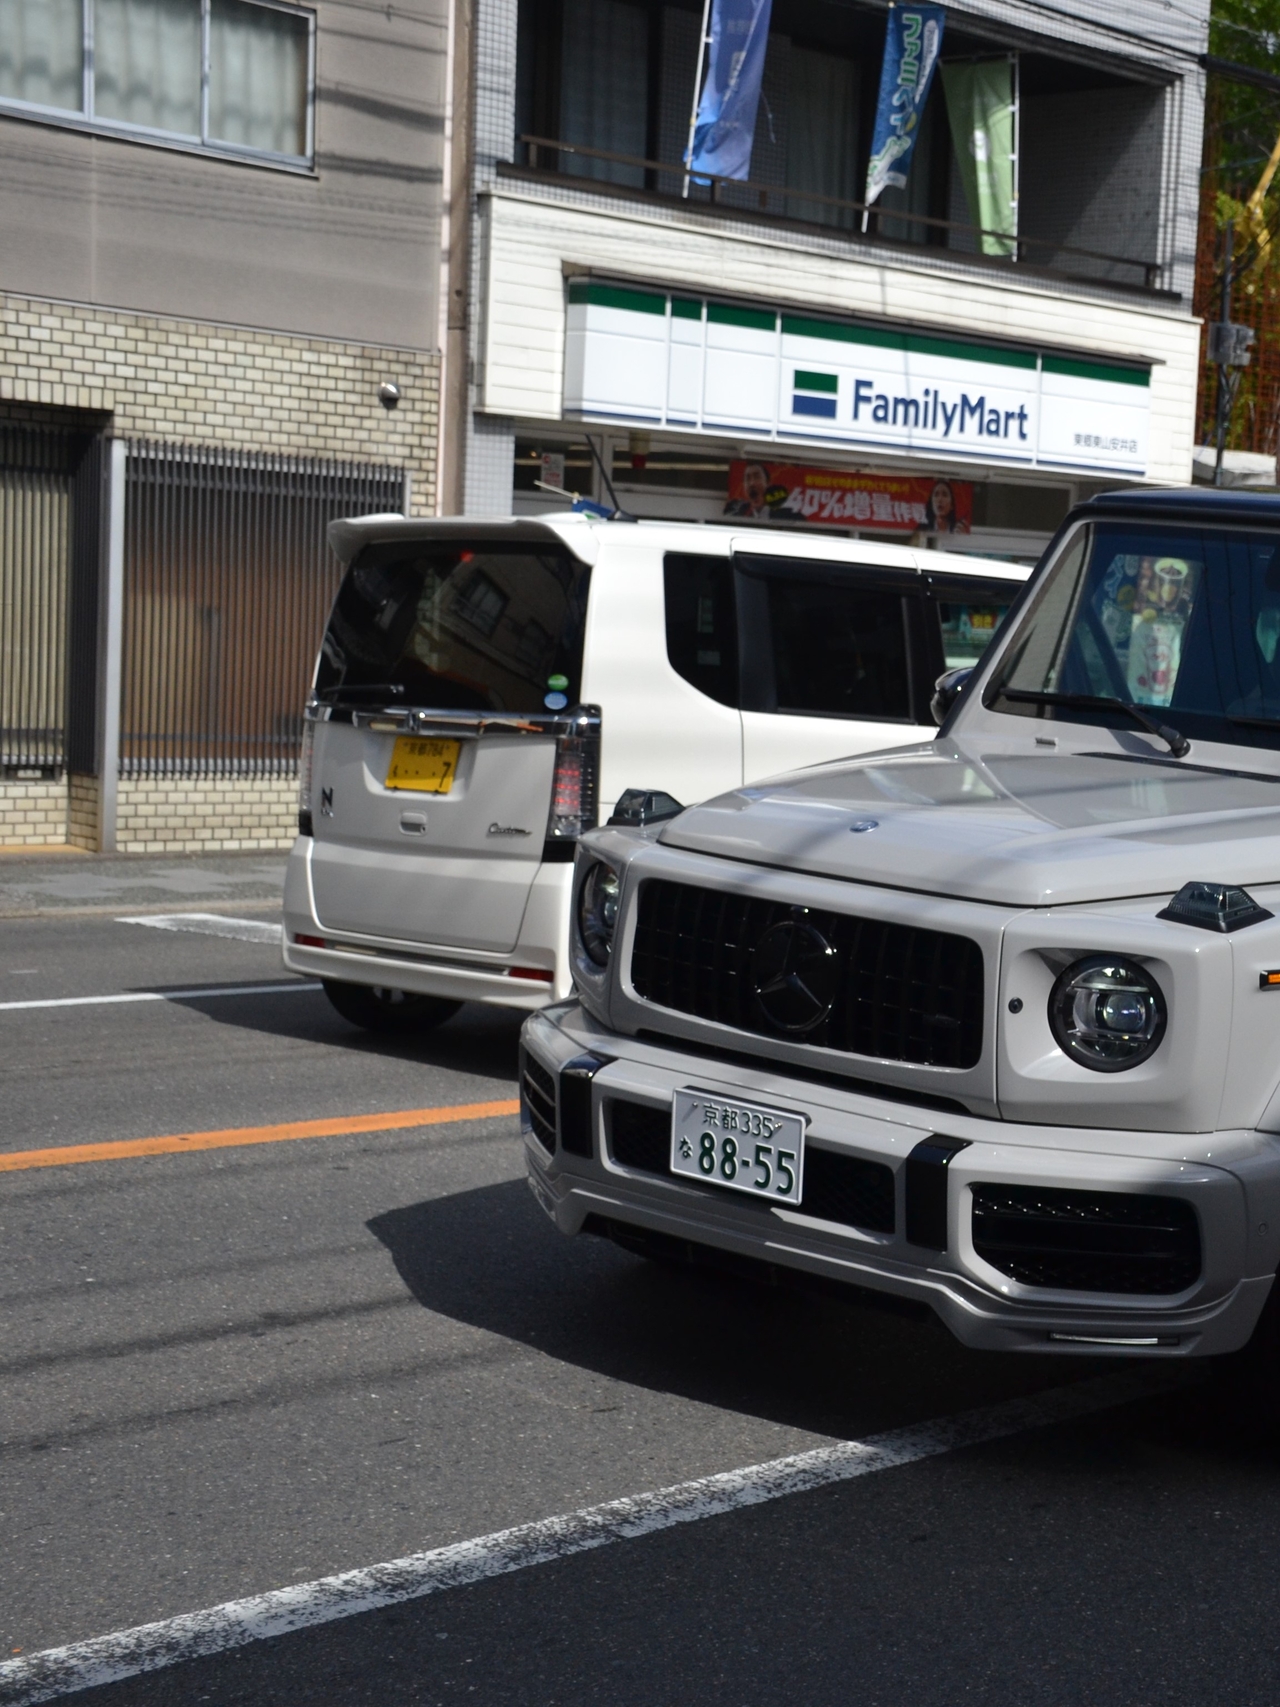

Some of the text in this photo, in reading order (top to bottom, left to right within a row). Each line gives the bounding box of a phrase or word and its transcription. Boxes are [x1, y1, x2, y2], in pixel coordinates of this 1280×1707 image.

[852, 379, 1028, 440] FamilyMart
[702, 1101, 775, 1139] 京都335
[679, 1130, 797, 1195] な 88-55
